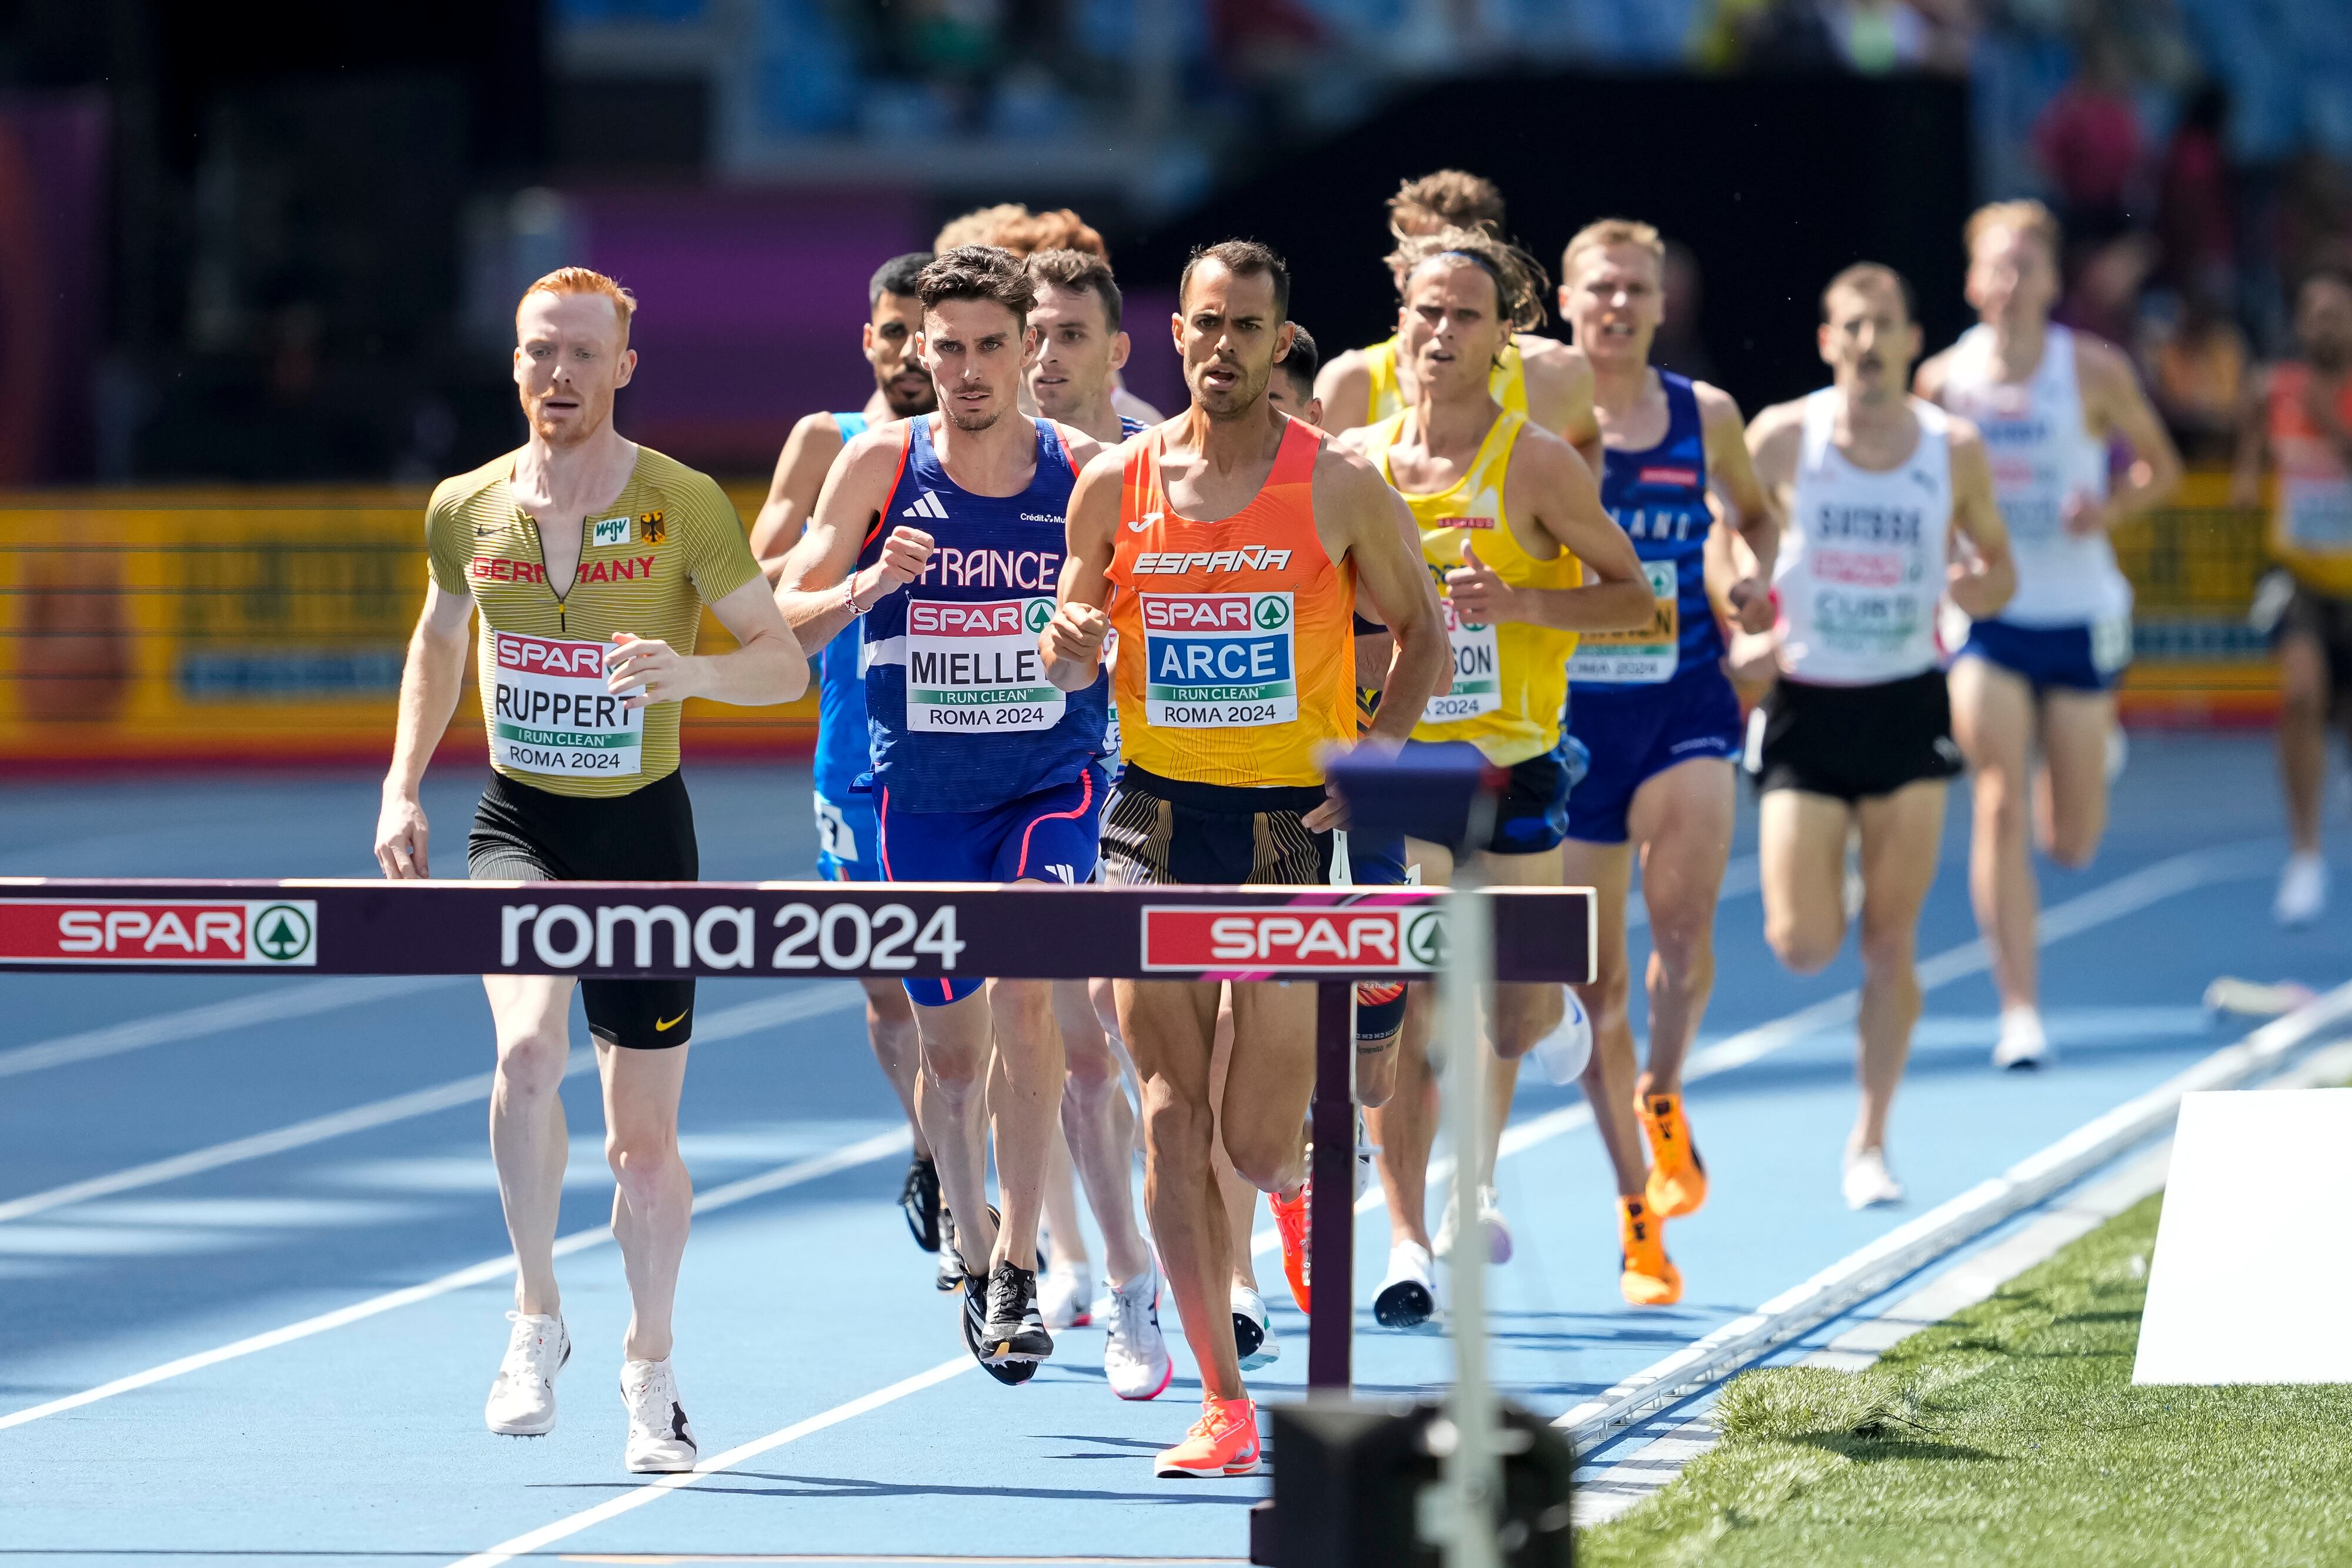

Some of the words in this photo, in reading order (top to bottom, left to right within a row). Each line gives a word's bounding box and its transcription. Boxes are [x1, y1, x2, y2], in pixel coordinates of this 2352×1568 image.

[1020, 513, 1044, 522] Crédit
[1054, 516, 1066, 524] Mu
[473, 555, 655, 584] GERMANY
[920, 548, 1059, 590] FRANCE
[1132, 544, 1293, 574] ESPAÑA
[913, 607, 1020, 631] SPAR
[1147, 601, 1248, 627] SPAR
[499, 638, 600, 674] SPAR
[912, 648, 1049, 684] MIELLE
[1160, 641, 1276, 679] ARCE
[496, 684, 636, 727] RUPPERT
[940, 693, 944, 703] I
[947, 692, 977, 703] RUN
[1179, 688, 1208, 700] RUN
[1434, 699, 1479, 714] 2024
[930, 709, 991, 726] ROMA
[996, 707, 1044, 724] 2024
[1165, 706, 1223, 723] ROMA
[1228, 704, 1276, 723] 2024
[518, 729, 522, 740] I
[524, 730, 553, 744] RUN
[510, 746, 566, 768] ROMA
[572, 753, 620, 768] 2024
[58, 910, 242, 953] SPAR
[501, 904, 755, 969] roma
[772, 902, 966, 971] 2024
[1210, 917, 1396, 960] SPAR
